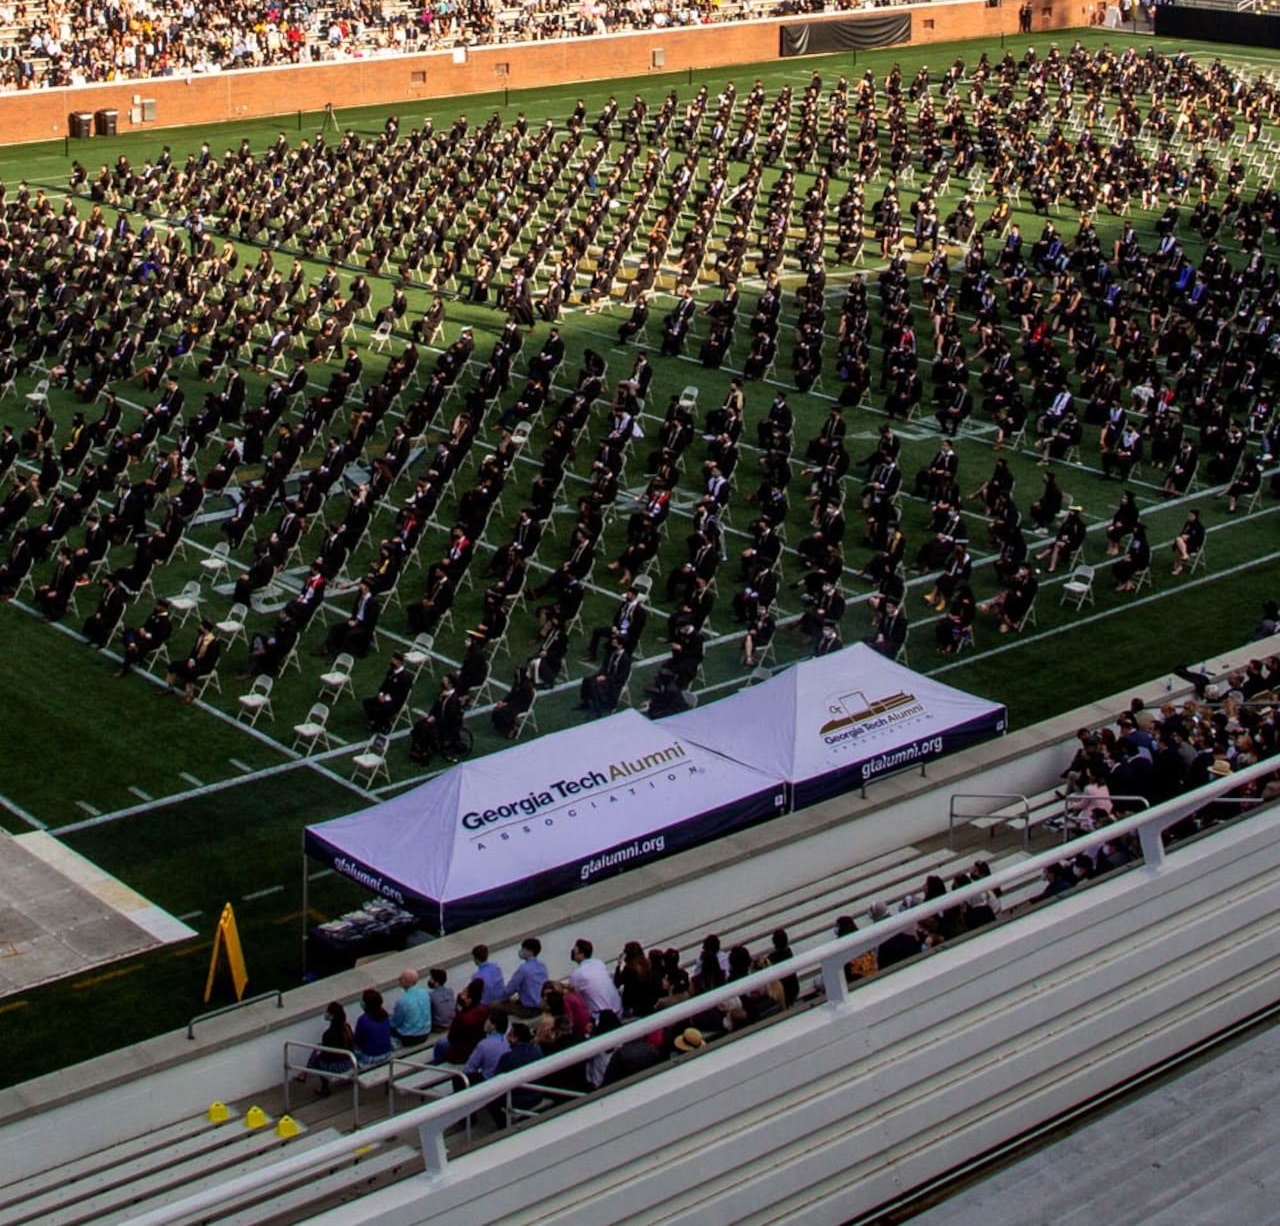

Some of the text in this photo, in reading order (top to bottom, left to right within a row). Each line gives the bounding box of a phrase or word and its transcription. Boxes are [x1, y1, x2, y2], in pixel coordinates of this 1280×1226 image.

[824, 728, 865, 745] Georgia
[861, 717, 888, 731] Tech
[888, 703, 924, 723] Alumni
[861, 736, 944, 779] gtalumni.org
[461, 742, 687, 830] Georgia Tech Alumni
[477, 765, 698, 851] ASSOCIATION
[580, 835, 665, 880] gtalumni.org
[334, 857, 405, 905] gtalumni.org
